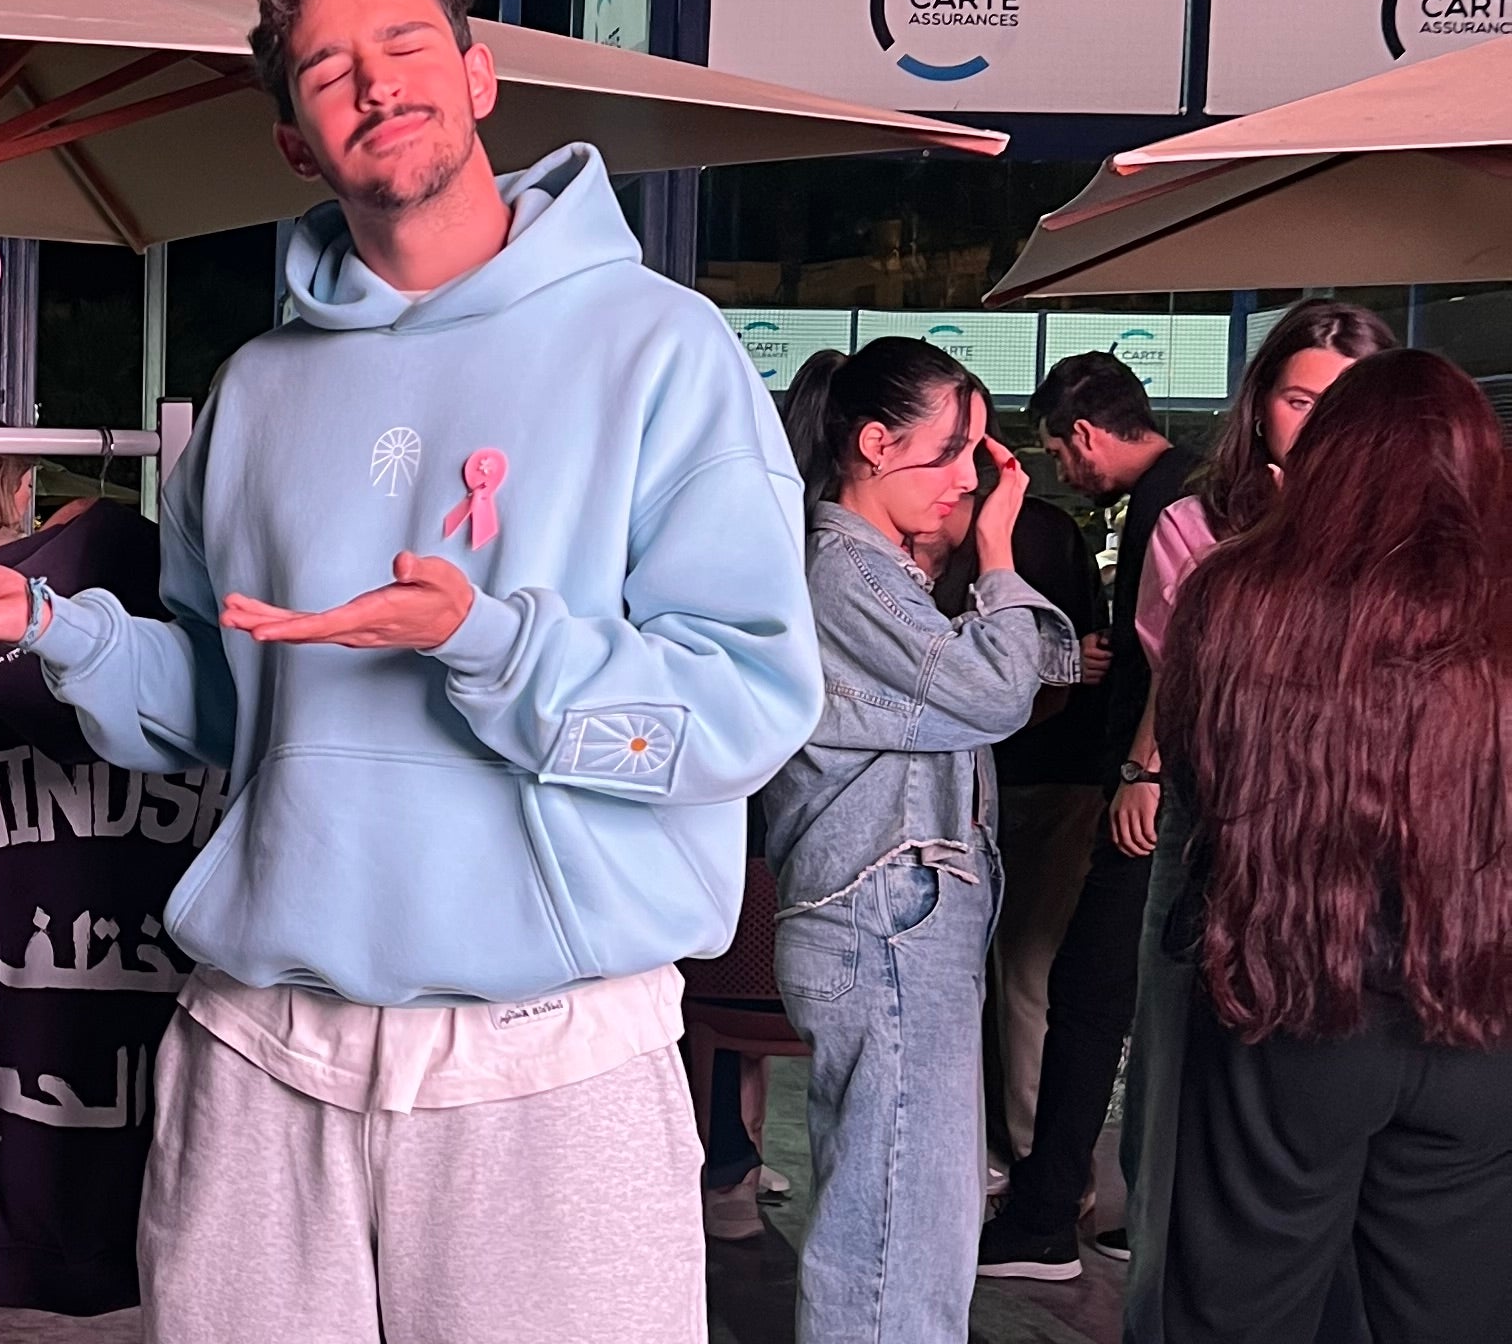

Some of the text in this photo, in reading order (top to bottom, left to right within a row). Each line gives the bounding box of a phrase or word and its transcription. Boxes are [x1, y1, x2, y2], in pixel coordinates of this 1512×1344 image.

[908, 12, 1020, 27] ASSURANCES
[1419, 21, 1512, 35] ASSURANC
[746, 342, 789, 353] CARTE
[941, 345, 974, 357] ARTE
[1121, 350, 1165, 361] CARTE
